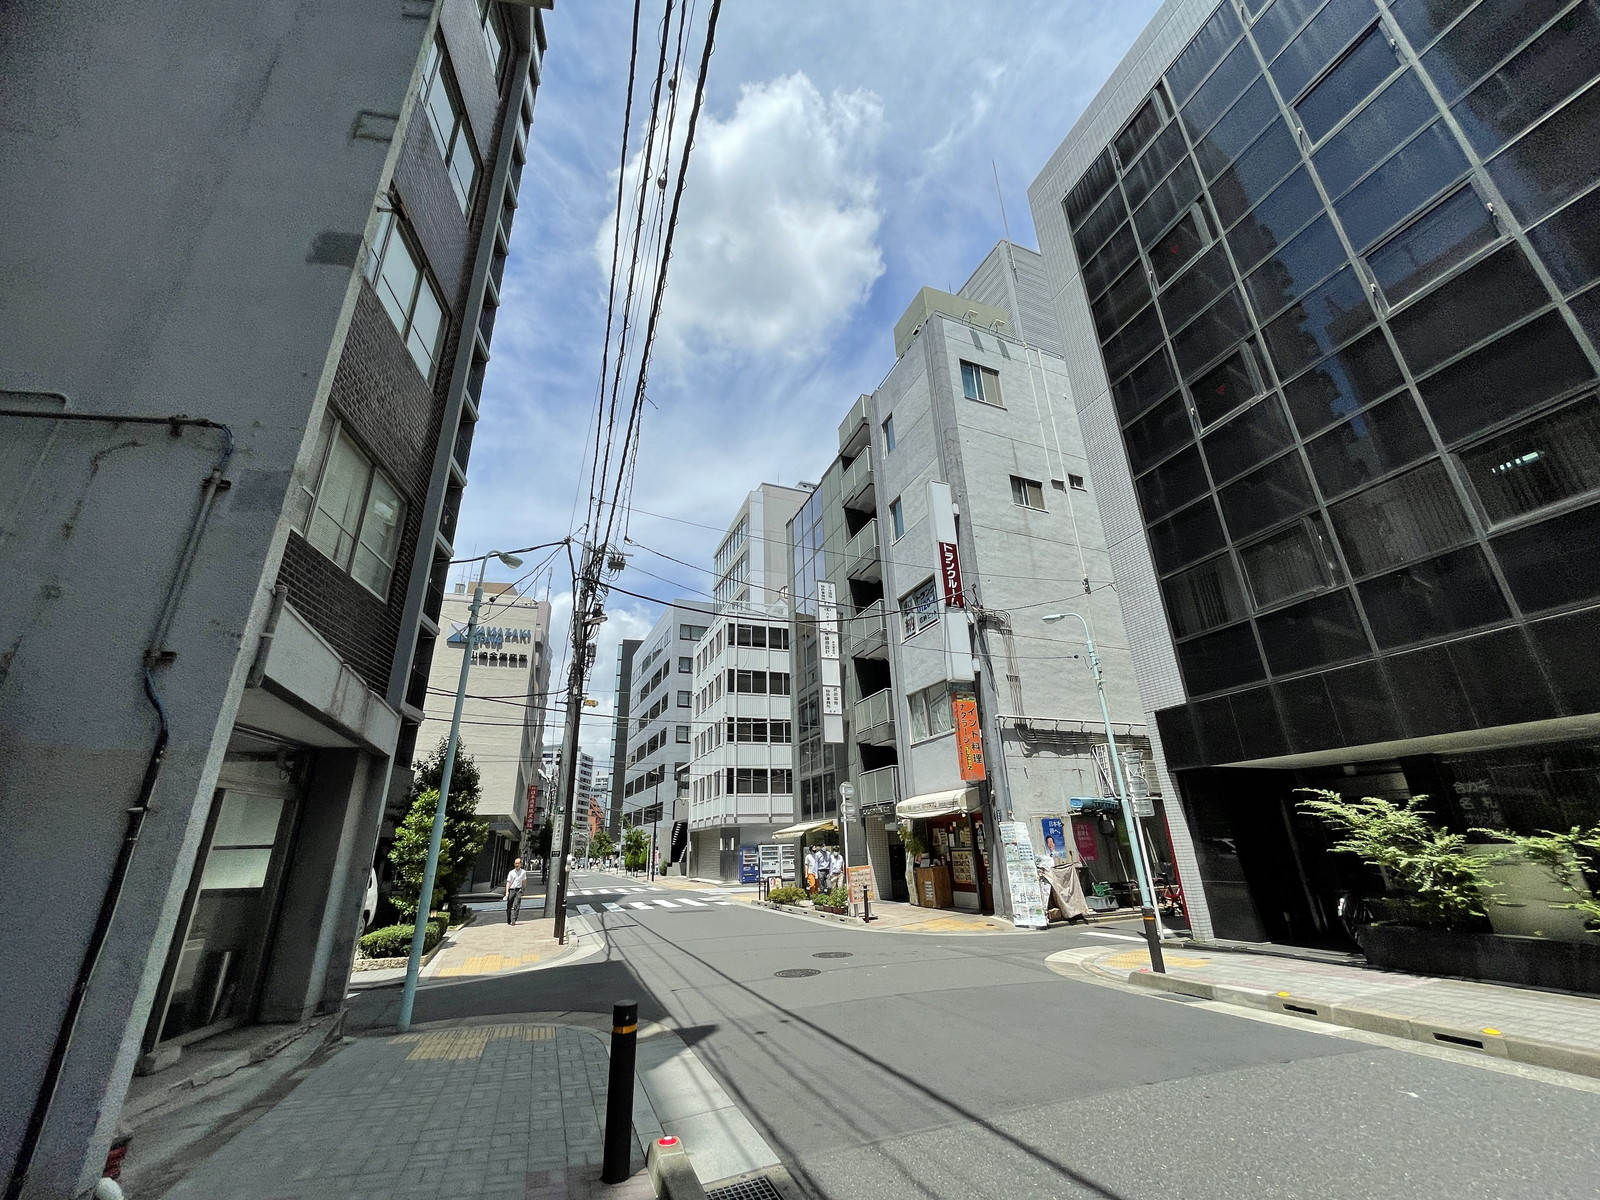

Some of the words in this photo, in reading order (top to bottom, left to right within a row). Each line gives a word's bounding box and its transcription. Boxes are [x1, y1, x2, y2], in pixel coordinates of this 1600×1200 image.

[943, 543, 960, 607] トランクルーム
[959, 704, 971, 744] ナタラージ
[968, 708, 982, 763] インド料理
